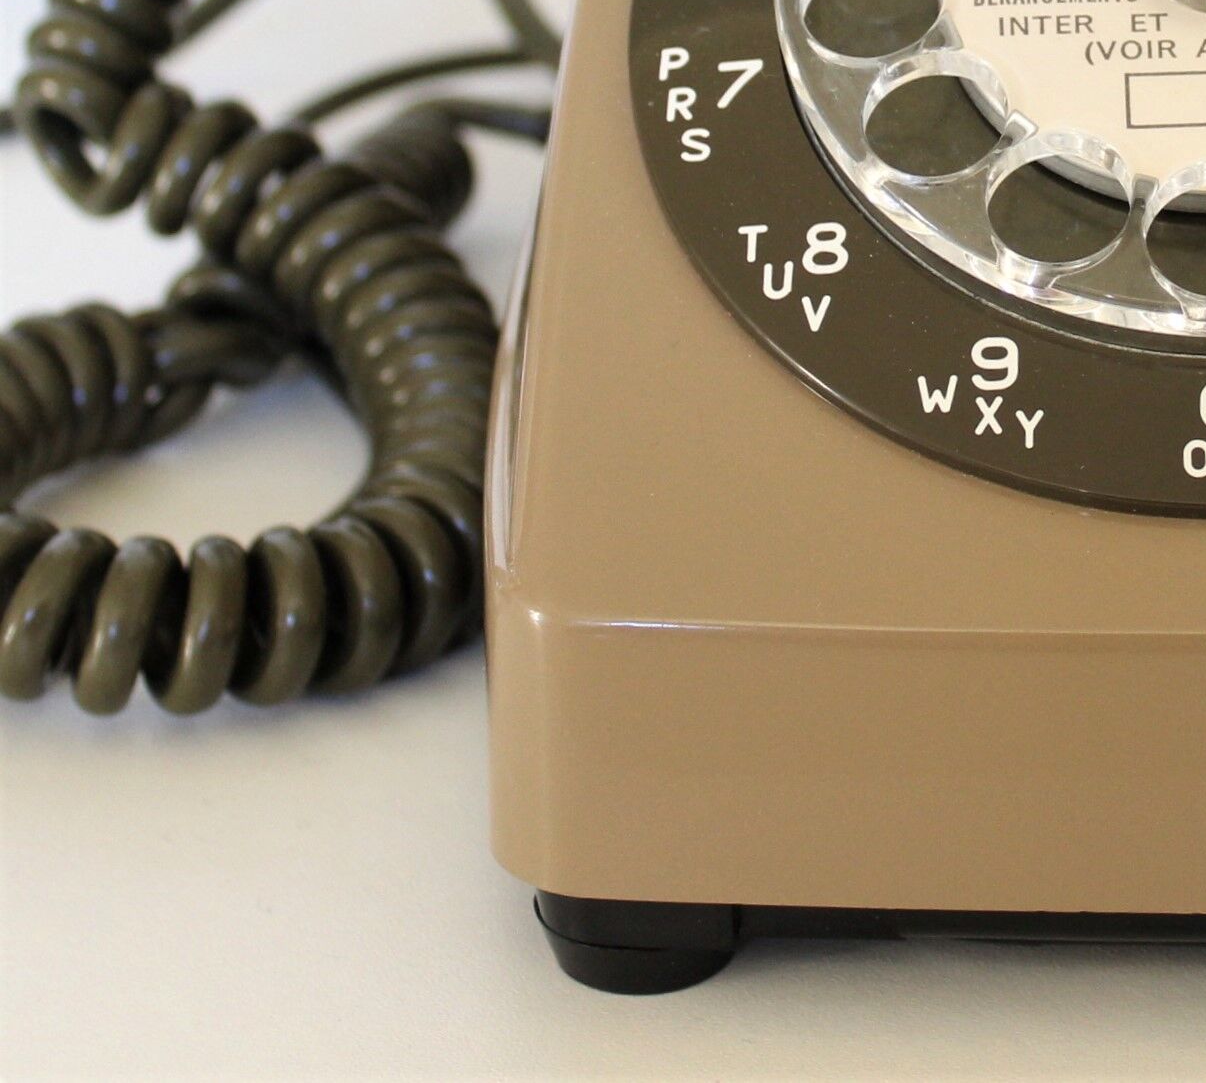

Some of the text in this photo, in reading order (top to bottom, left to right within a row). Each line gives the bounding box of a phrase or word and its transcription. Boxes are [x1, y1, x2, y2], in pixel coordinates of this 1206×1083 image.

[998, 14, 1094, 37] INTER
[1131, 13, 1168, 33] ET
[1084, 39, 1178, 65] (VOIR
[717, 59, 764, 109] 7
[802, 222, 848, 274] 8
[970, 336, 1019, 391] 9
